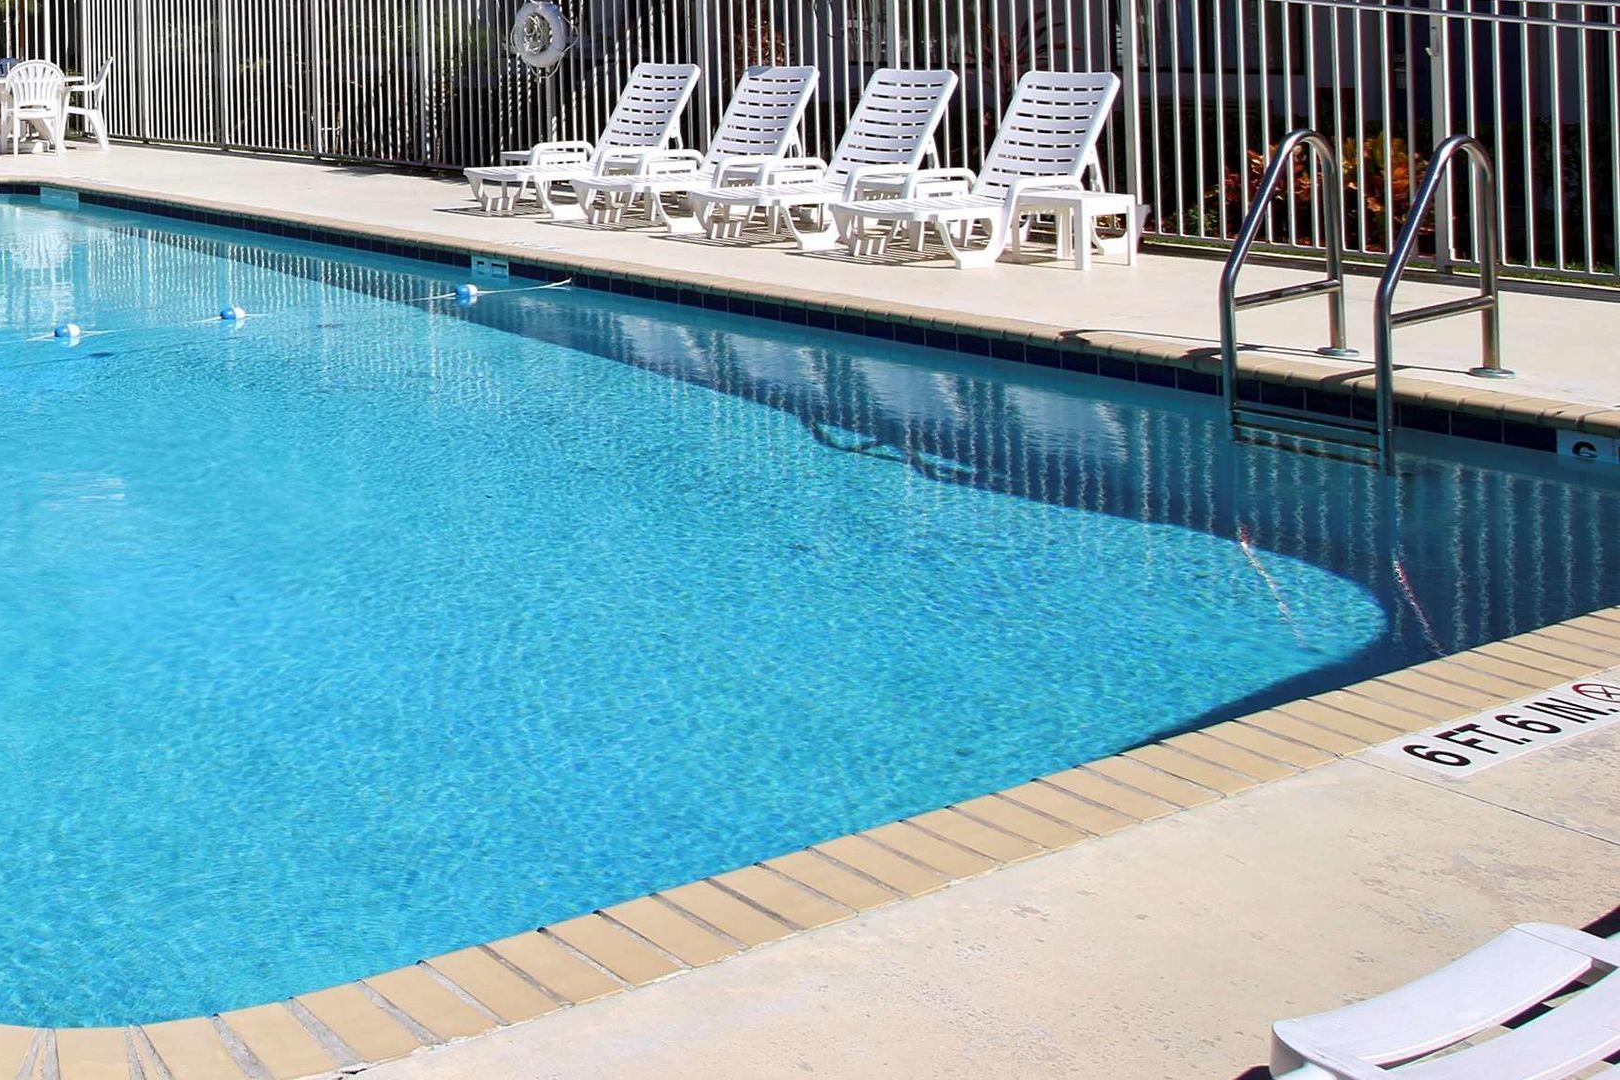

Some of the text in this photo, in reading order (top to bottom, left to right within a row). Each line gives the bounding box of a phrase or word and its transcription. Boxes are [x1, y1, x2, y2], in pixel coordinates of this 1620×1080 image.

[1403, 697, 1620, 767] 6 FT. 6 IN.
